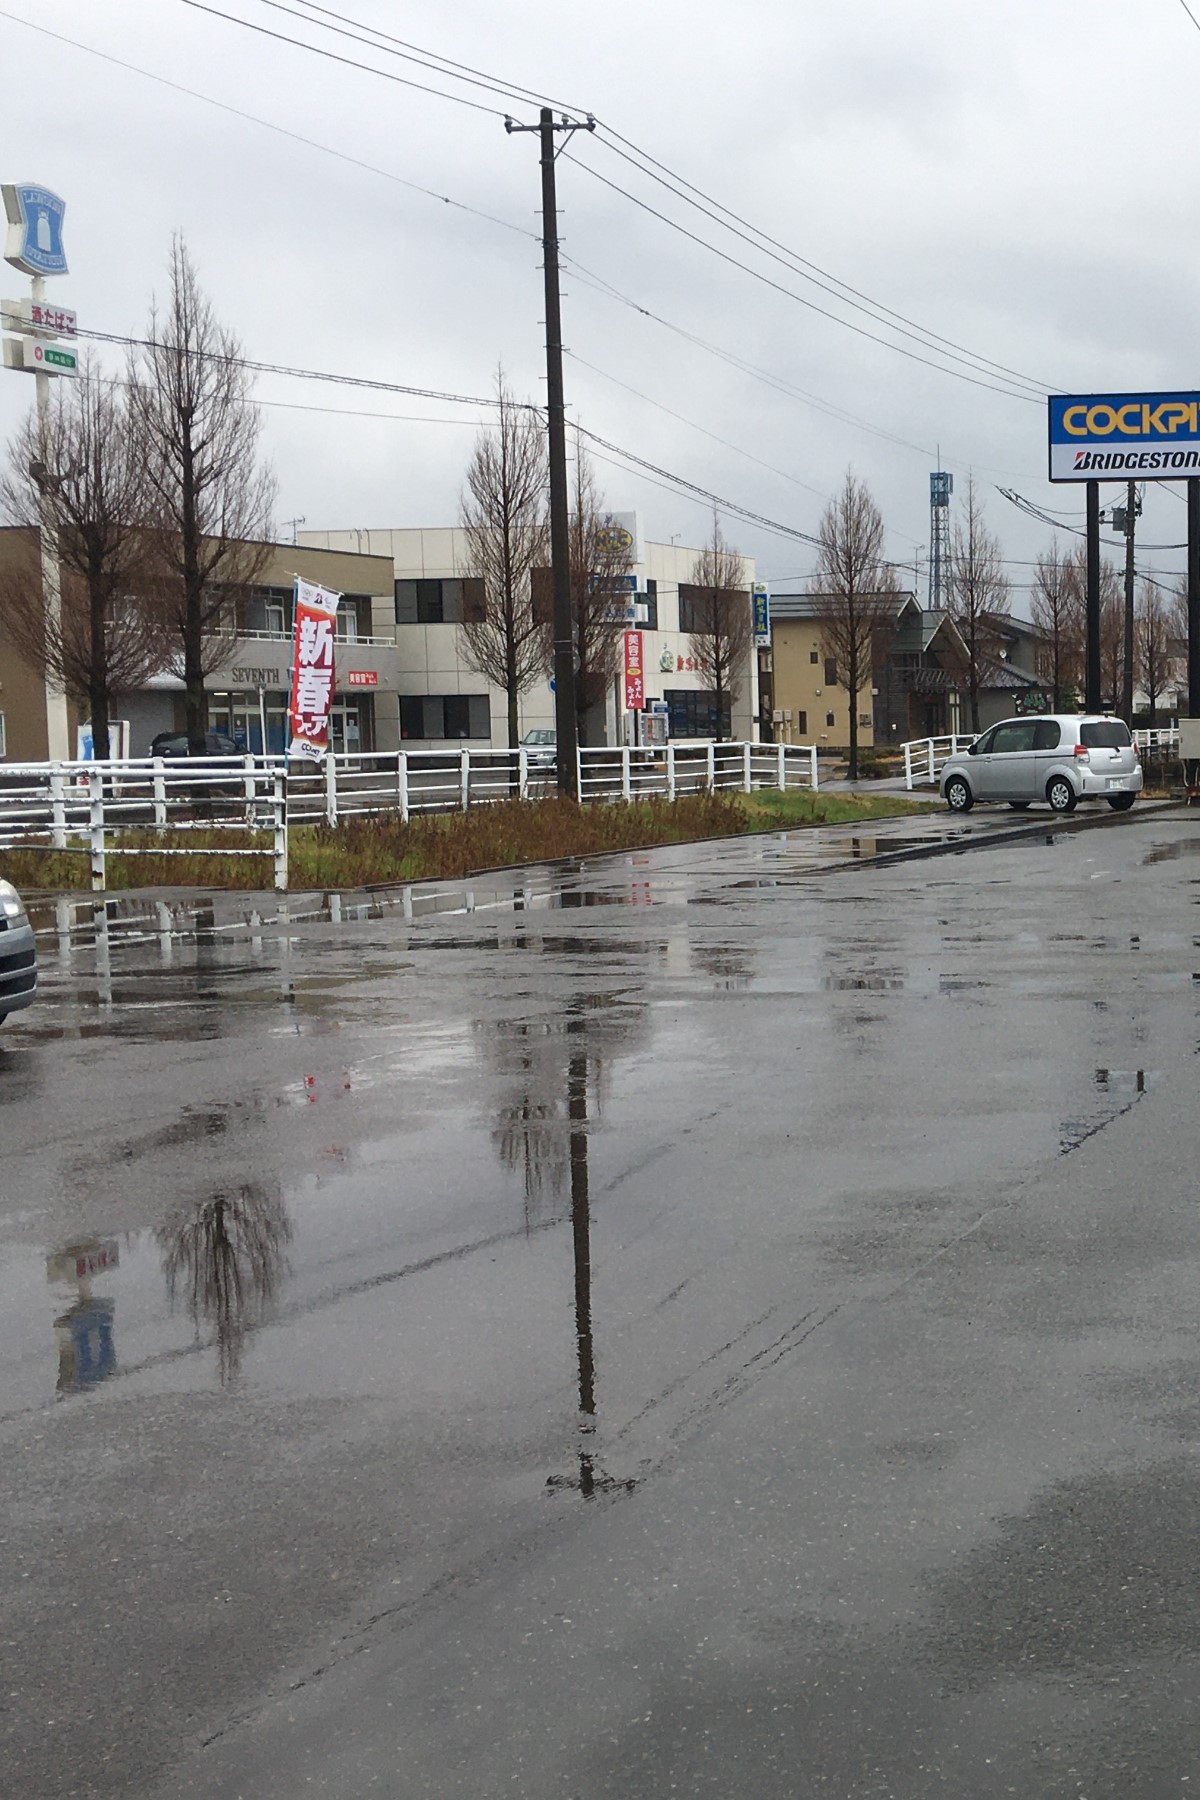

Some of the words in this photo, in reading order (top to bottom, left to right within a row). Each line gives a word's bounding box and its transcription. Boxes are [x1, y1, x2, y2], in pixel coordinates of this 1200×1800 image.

[297, 616, 333, 714] 新春
[628, 634, 639, 667] 美容室
[232, 668, 279, 683] SEVENTH
